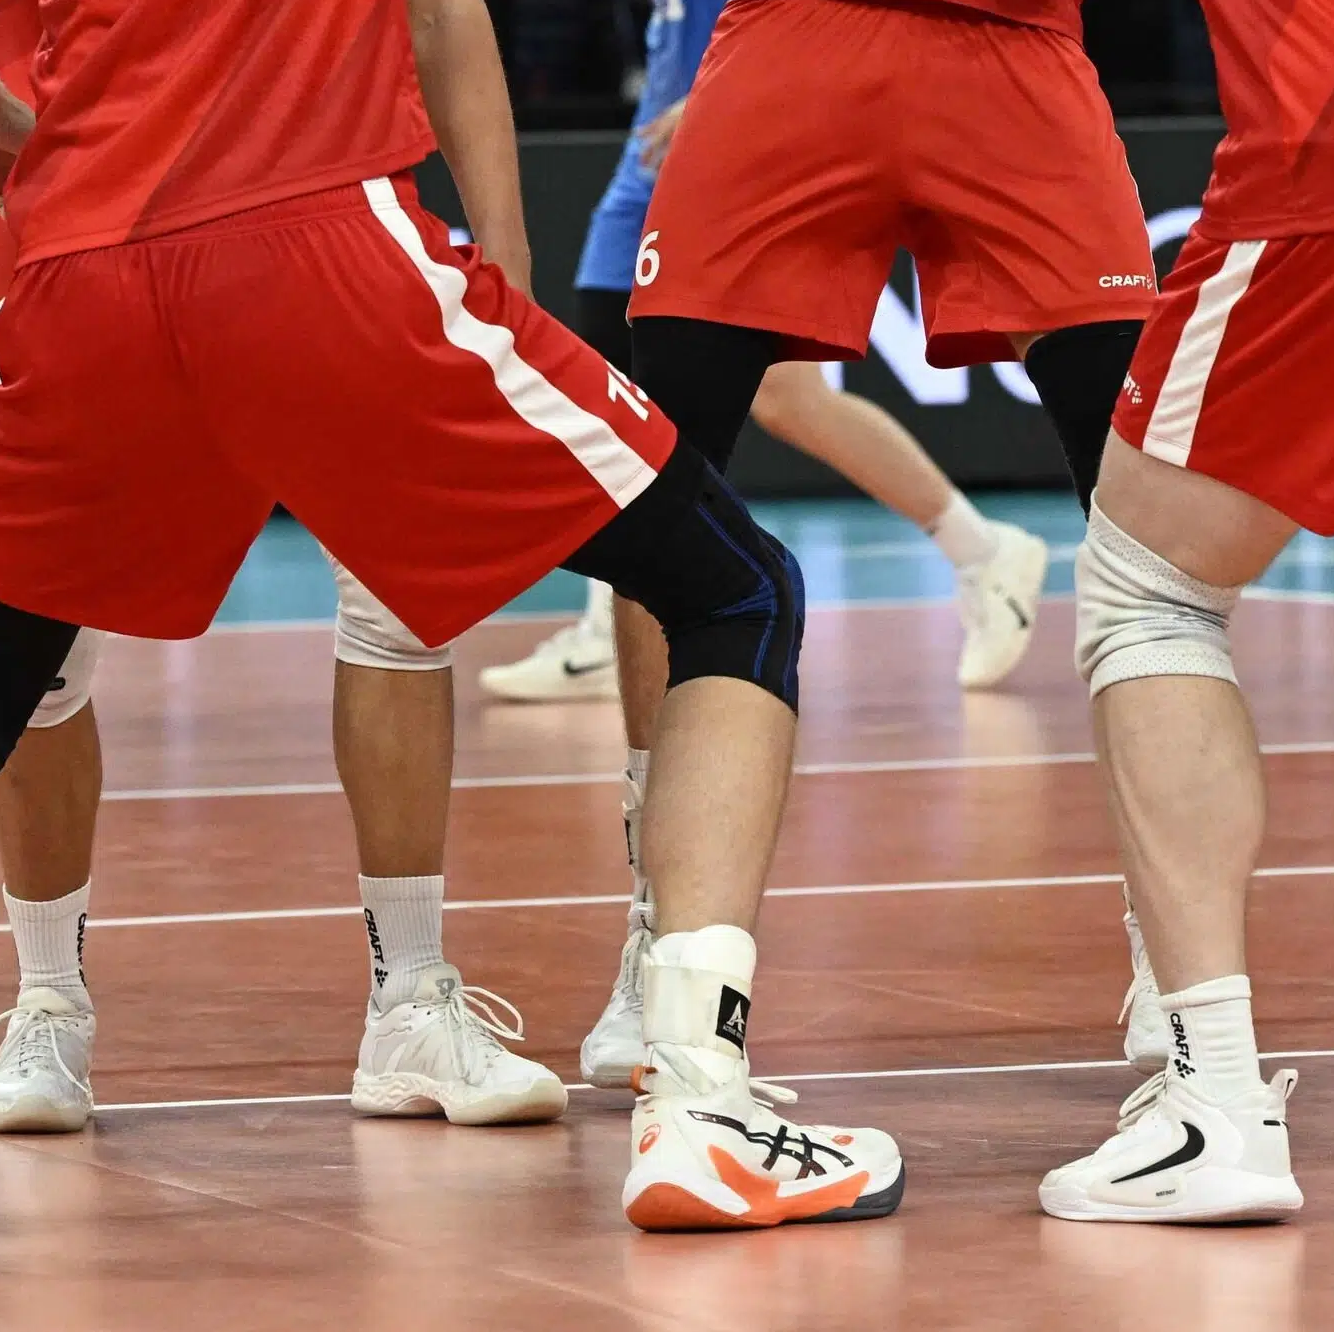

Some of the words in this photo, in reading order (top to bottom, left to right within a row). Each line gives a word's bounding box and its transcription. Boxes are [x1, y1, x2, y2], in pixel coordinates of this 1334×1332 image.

[635, 230, 660, 287] 6
[1098, 274, 1147, 288] CRAFT
[363, 907, 385, 964] CRAFT
[1169, 1012, 1192, 1062] CRAFT
